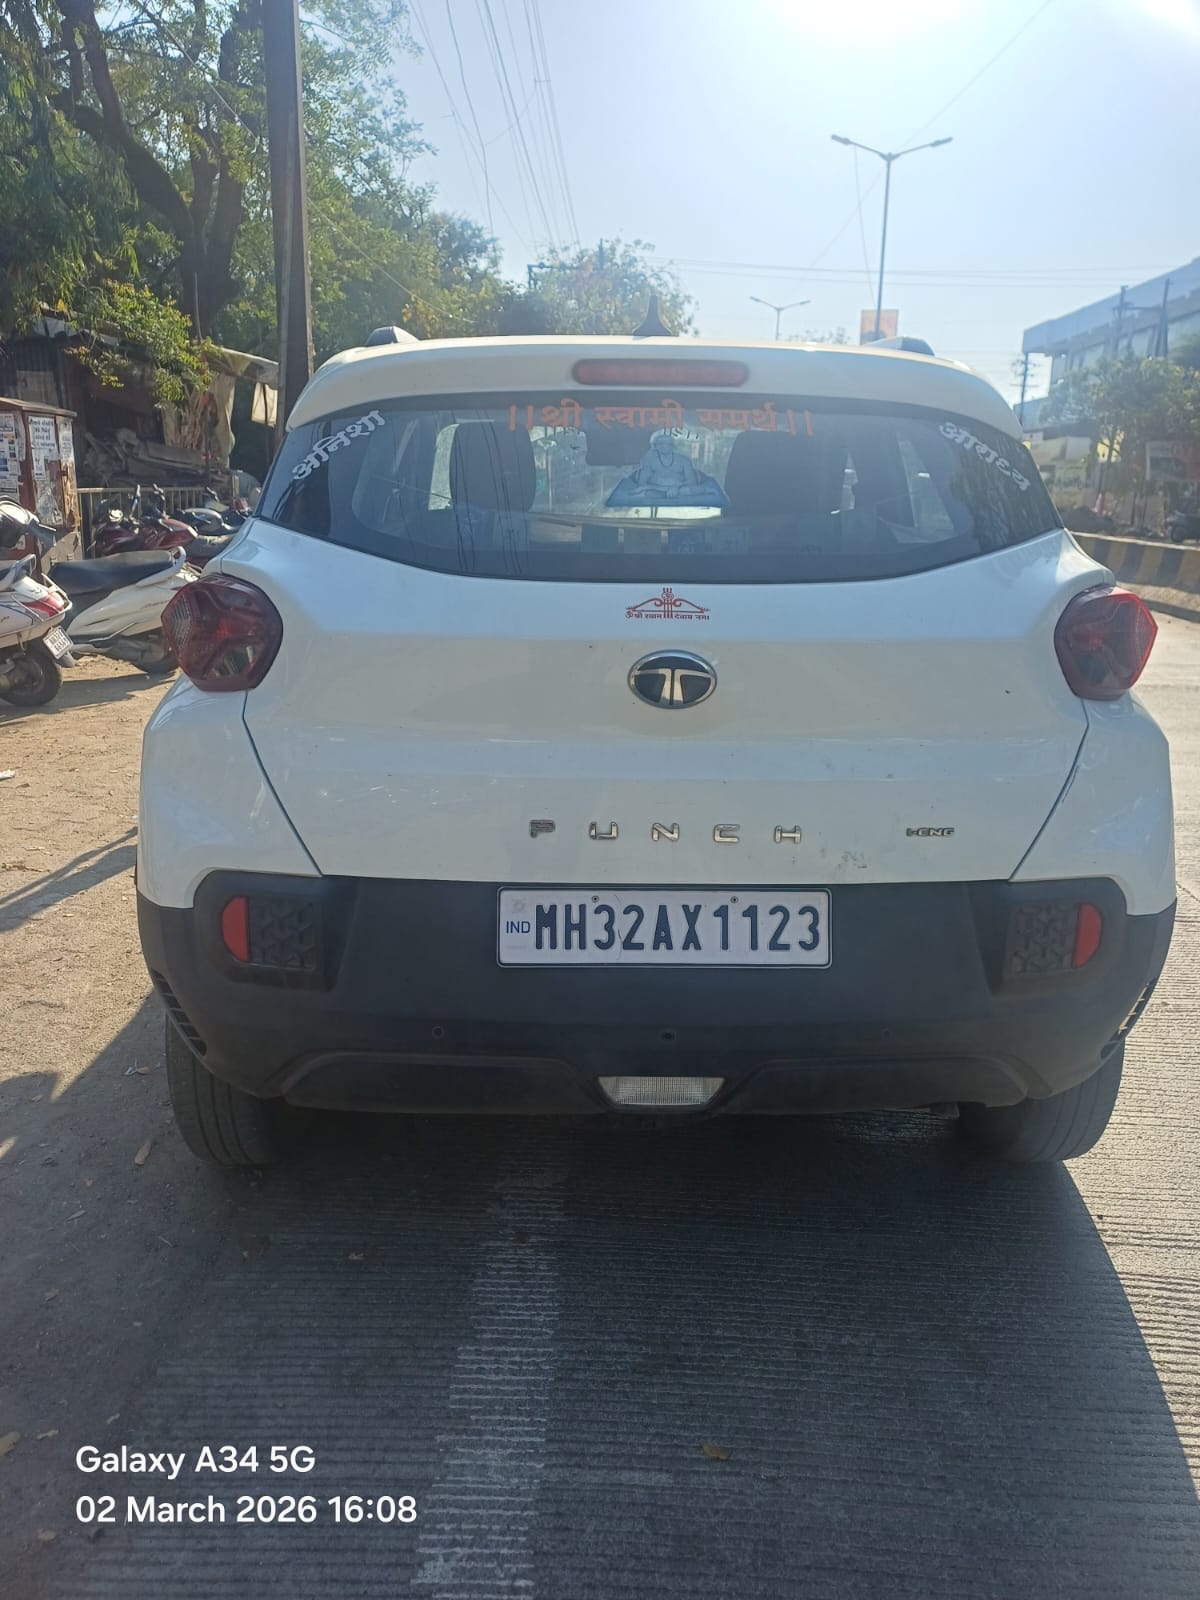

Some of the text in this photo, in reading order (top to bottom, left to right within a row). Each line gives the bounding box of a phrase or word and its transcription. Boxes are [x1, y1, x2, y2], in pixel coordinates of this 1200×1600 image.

[594, 399, 684, 430] स्वामी
[292, 410, 386, 480] अनिशा
[939, 421, 1031, 491] आराध्य
[529, 820, 801, 843] PUNCH
[506, 904, 820, 951] IND MH32AX1123
